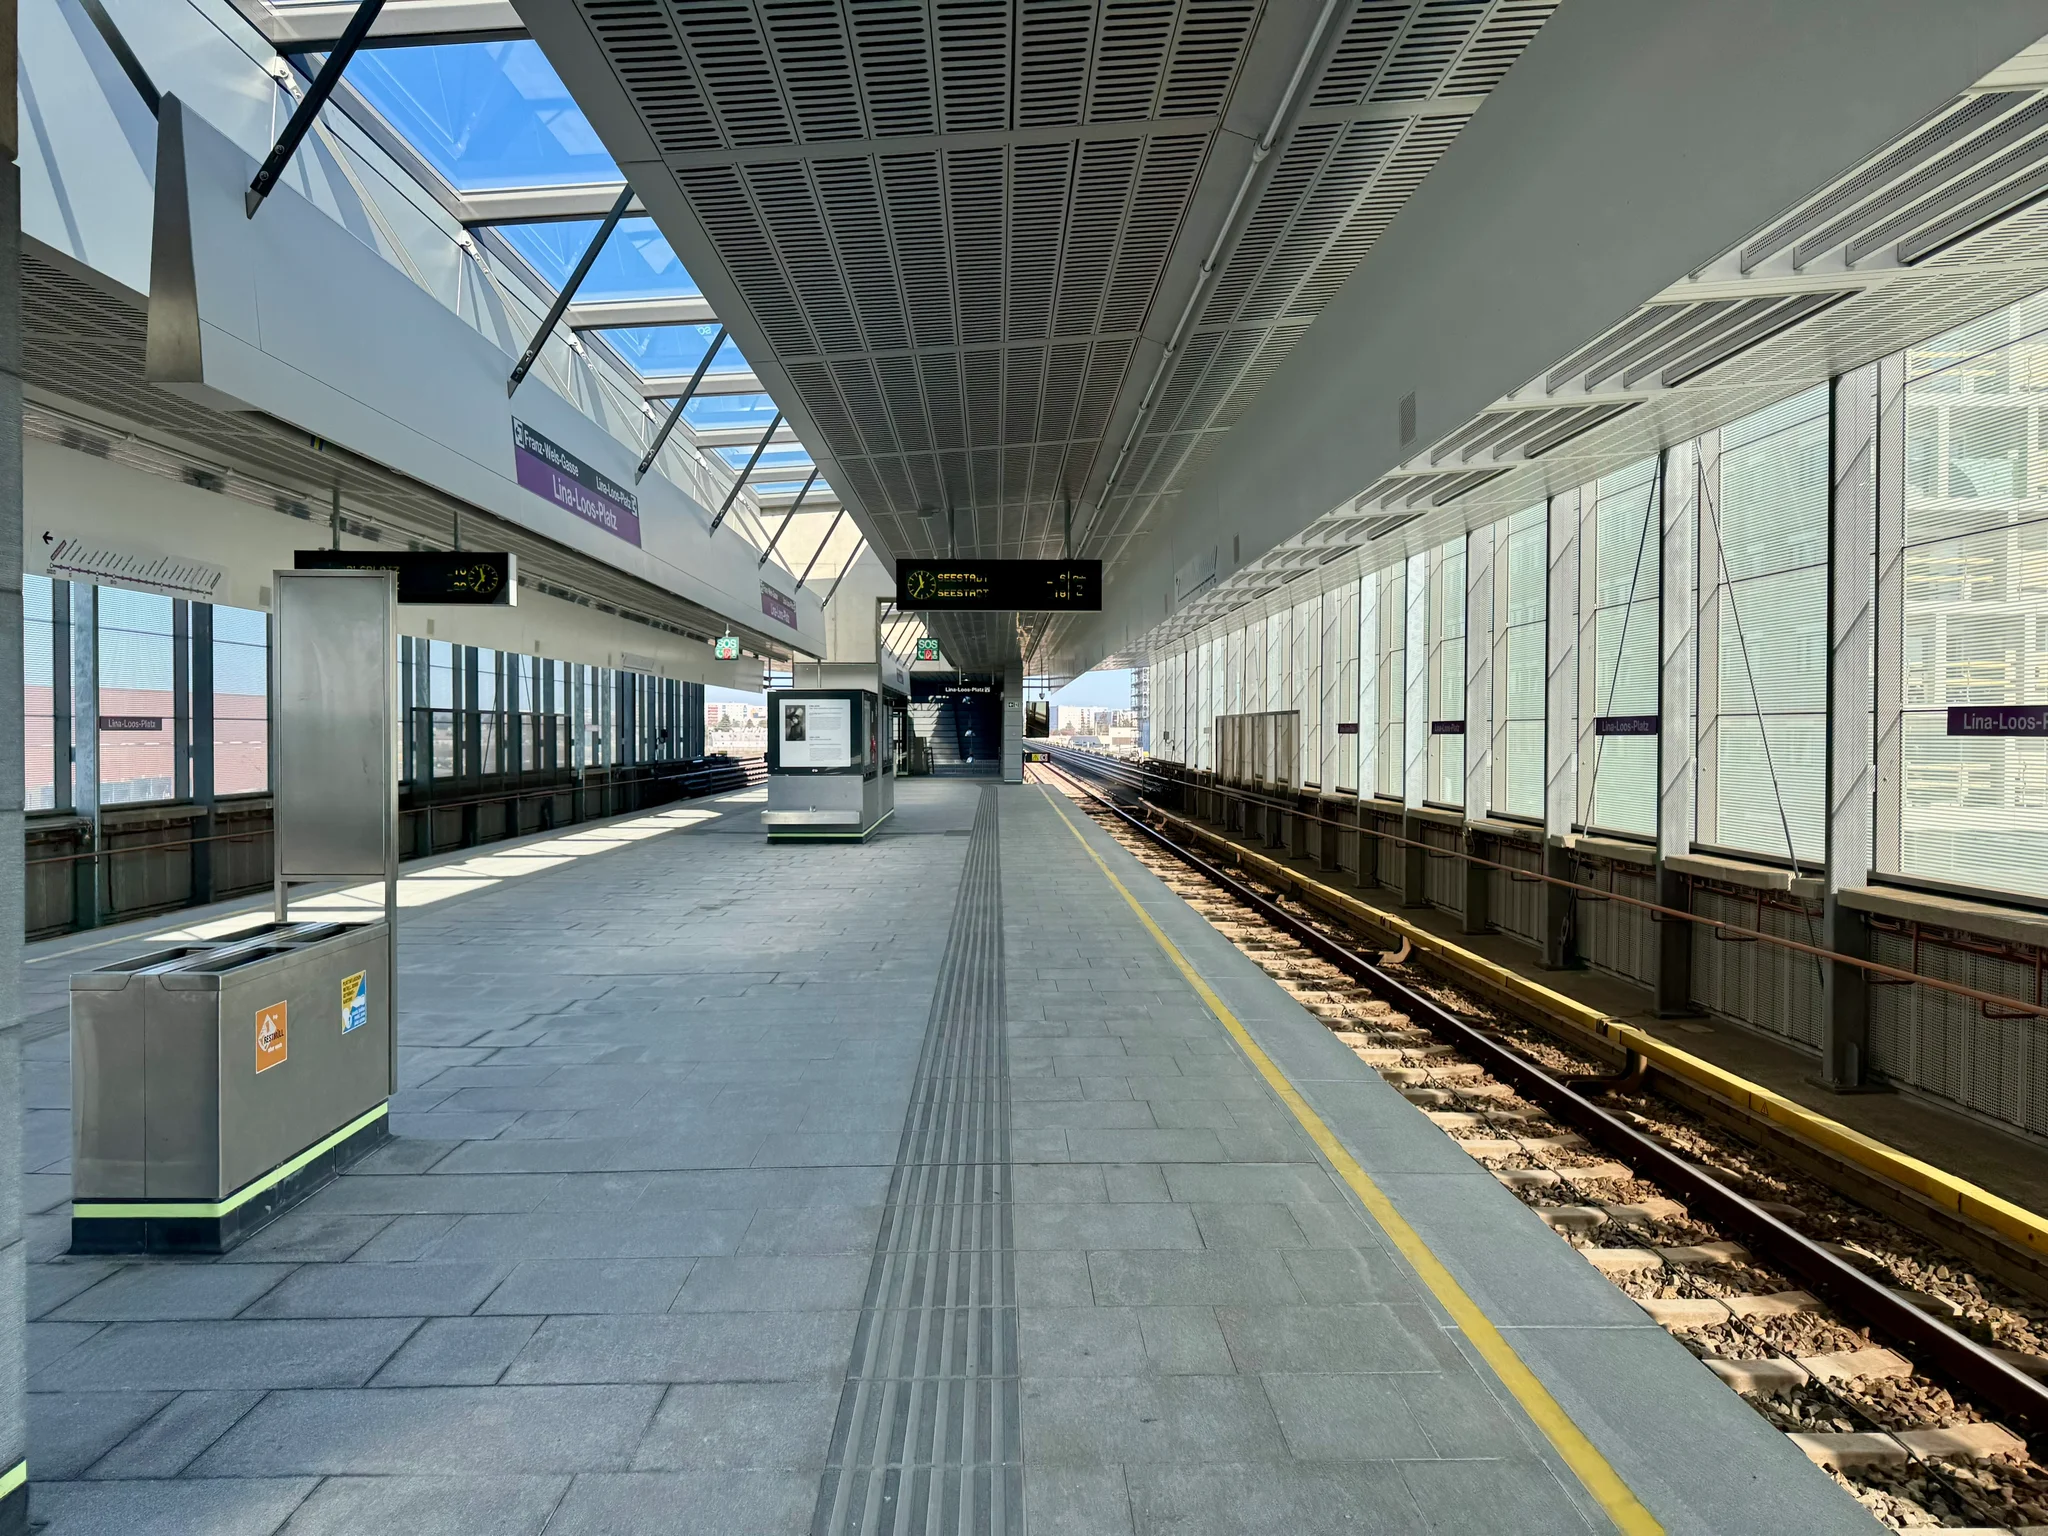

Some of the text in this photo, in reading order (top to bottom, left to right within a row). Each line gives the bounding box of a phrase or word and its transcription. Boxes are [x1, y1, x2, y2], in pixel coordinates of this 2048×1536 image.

[596, 475, 631, 509] Lina-Loos-Platz
[552, 474, 618, 531] Lina-Loos-Platz
[717, 639, 737, 648] SOS
[918, 639, 938, 649] SOS
[108, 719, 156, 728] Lina-Loos-Platz
[1601, 719, 1649, 732] Lina-Loos-Platz
[263, 1028, 285, 1045] RESTMÜLL
